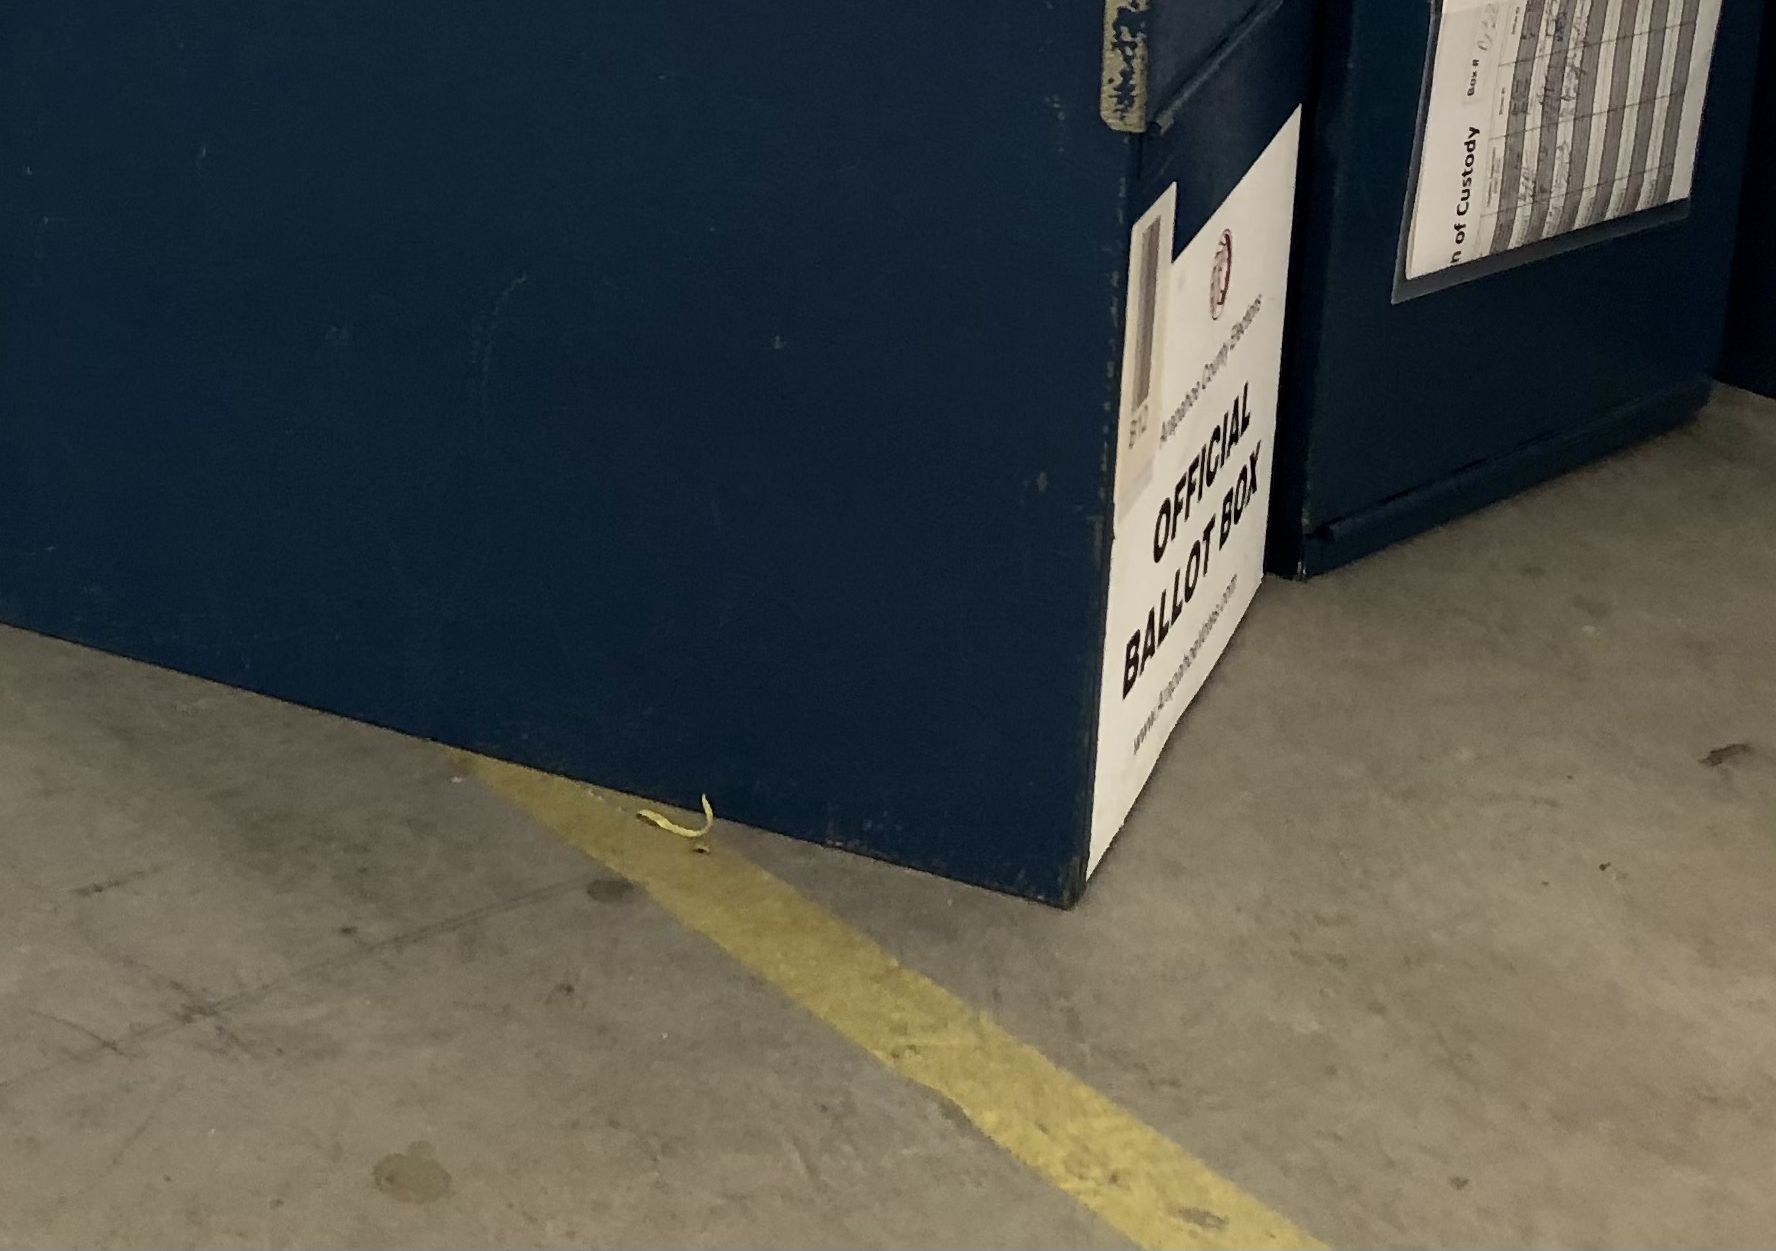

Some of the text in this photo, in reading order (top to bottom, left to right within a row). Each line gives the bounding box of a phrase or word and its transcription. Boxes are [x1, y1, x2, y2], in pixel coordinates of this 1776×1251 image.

[1454, 222, 1466, 245] of
[1456, 126, 1481, 217] Custody
[1152, 381, 1252, 564] OFFICIAL
[1122, 440, 1262, 702] BALLOT BOX
